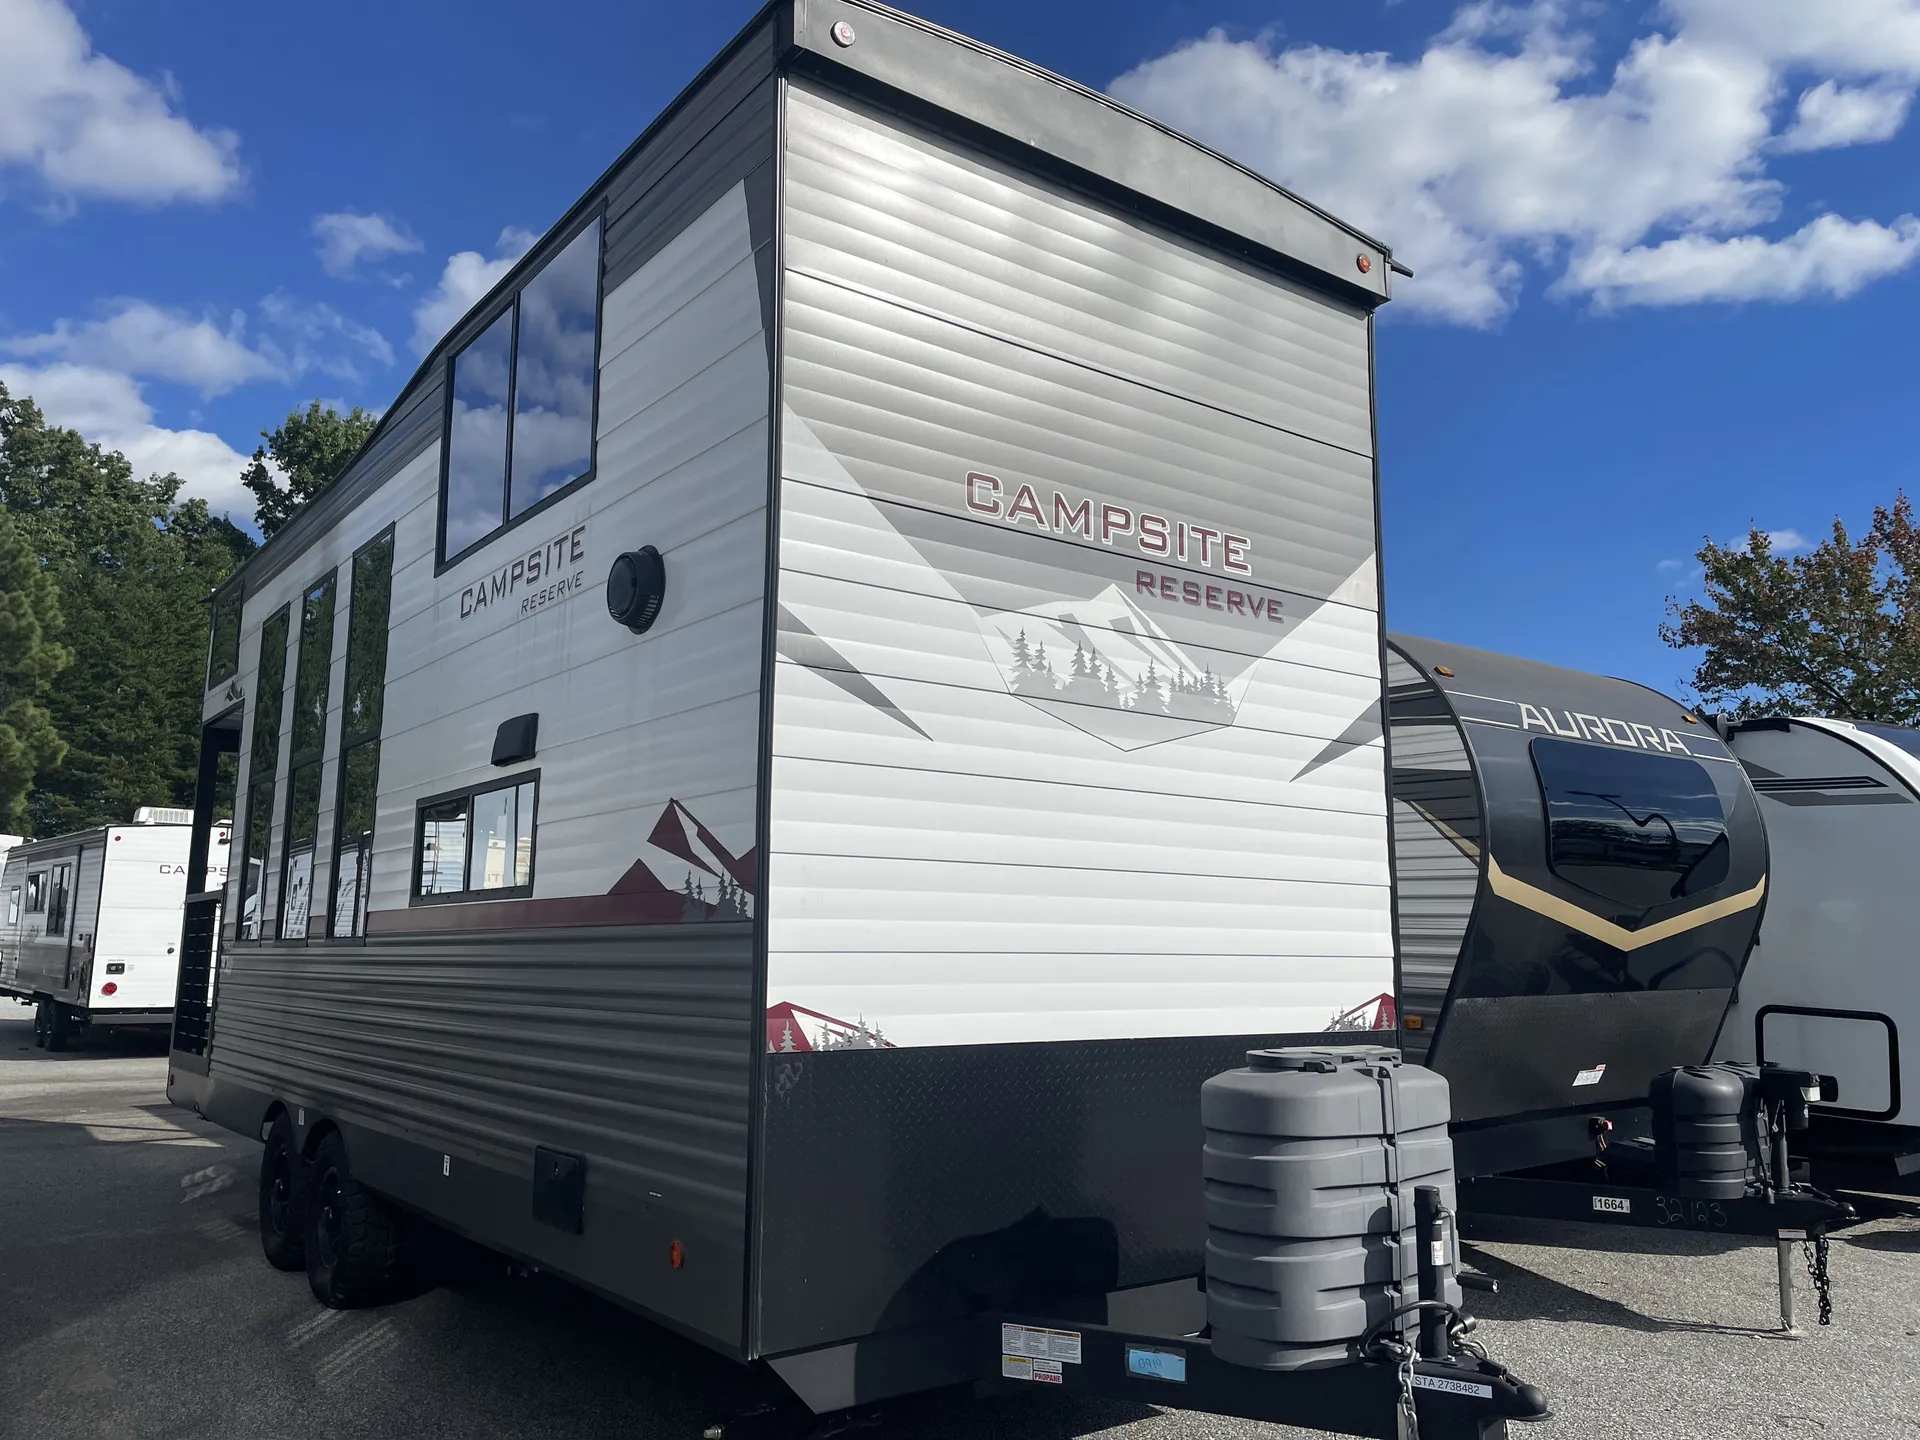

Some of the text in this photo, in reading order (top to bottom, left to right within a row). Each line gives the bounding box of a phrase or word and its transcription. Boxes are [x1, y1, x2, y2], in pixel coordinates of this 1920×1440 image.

[966, 471, 1252, 577] CAMPSITE
[460, 525, 586, 619] CAMPSITE
[521, 570, 584, 614] RESERVE
[1136, 569, 1284, 623] RESERVE
[1517, 702, 1692, 756] AURORA
[1597, 1198, 1625, 1211] 1664
[1034, 1373, 1061, 1383] PROPANE
[1415, 1376, 1480, 1394] STA 2738482
